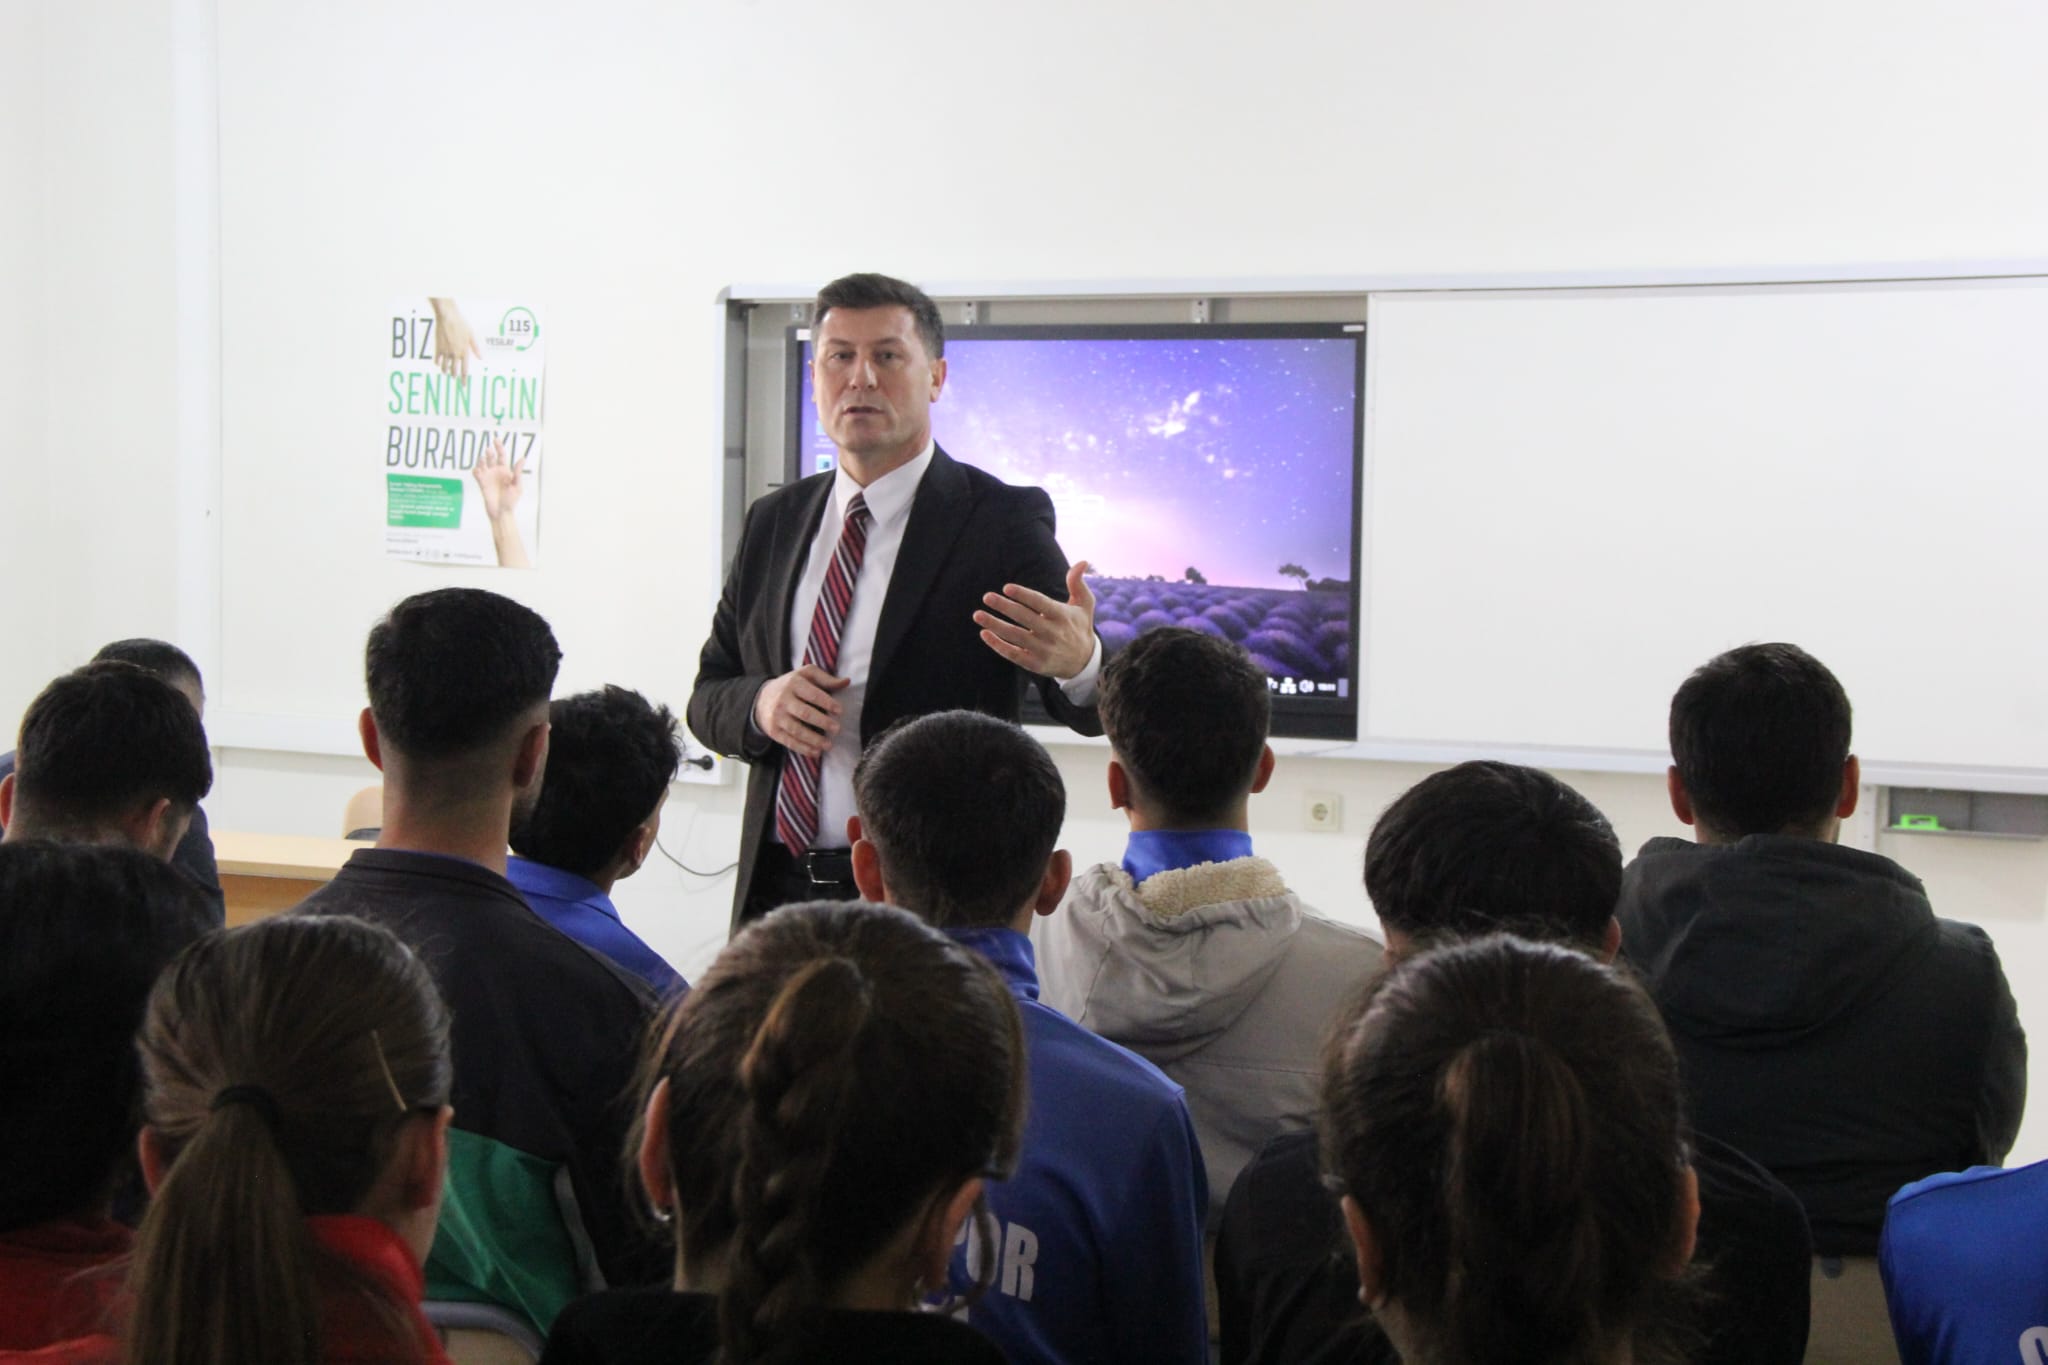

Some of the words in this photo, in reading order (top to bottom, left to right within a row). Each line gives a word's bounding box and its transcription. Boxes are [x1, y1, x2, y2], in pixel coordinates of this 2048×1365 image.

[392, 309, 434, 360] BİZ
[509, 319, 531, 332] 115
[480, 367, 537, 426] İÇİN
